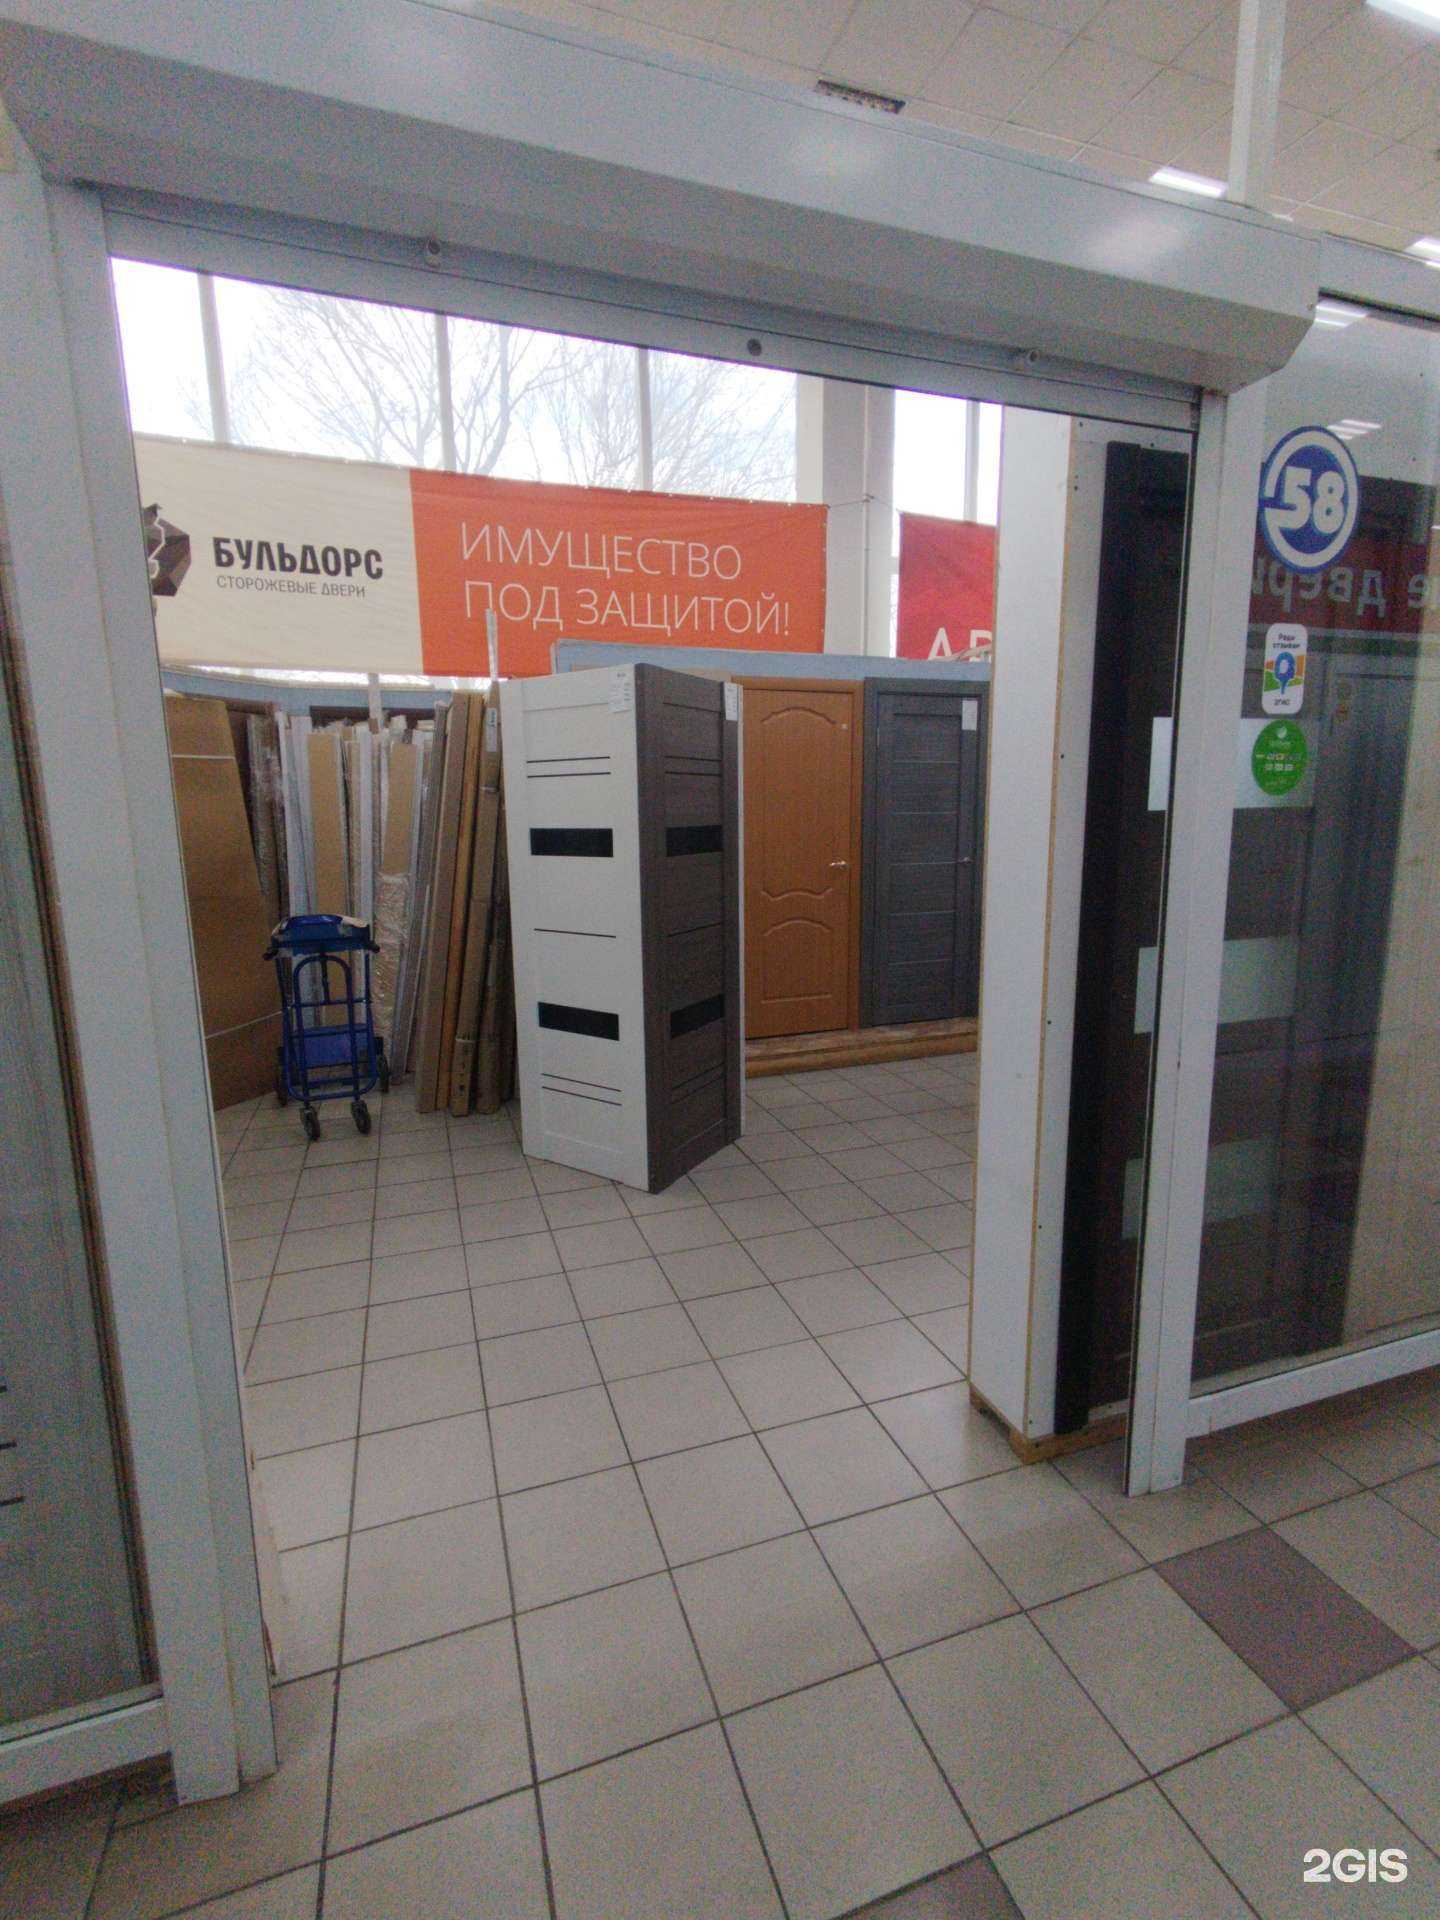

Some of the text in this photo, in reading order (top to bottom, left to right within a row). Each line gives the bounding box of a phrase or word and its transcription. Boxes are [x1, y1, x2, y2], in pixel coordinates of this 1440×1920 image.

[1266, 465, 1345, 534] 58
[212, 536, 384, 581] БУЛЬДОРС
[461, 521, 742, 580] ИМУЩЕСТВО
[216, 574, 366, 598] СТОРОЖЕВЫЕ ДВЕРИ
[464, 580, 790, 637] ПОД ЗАЩИТОЙ!
